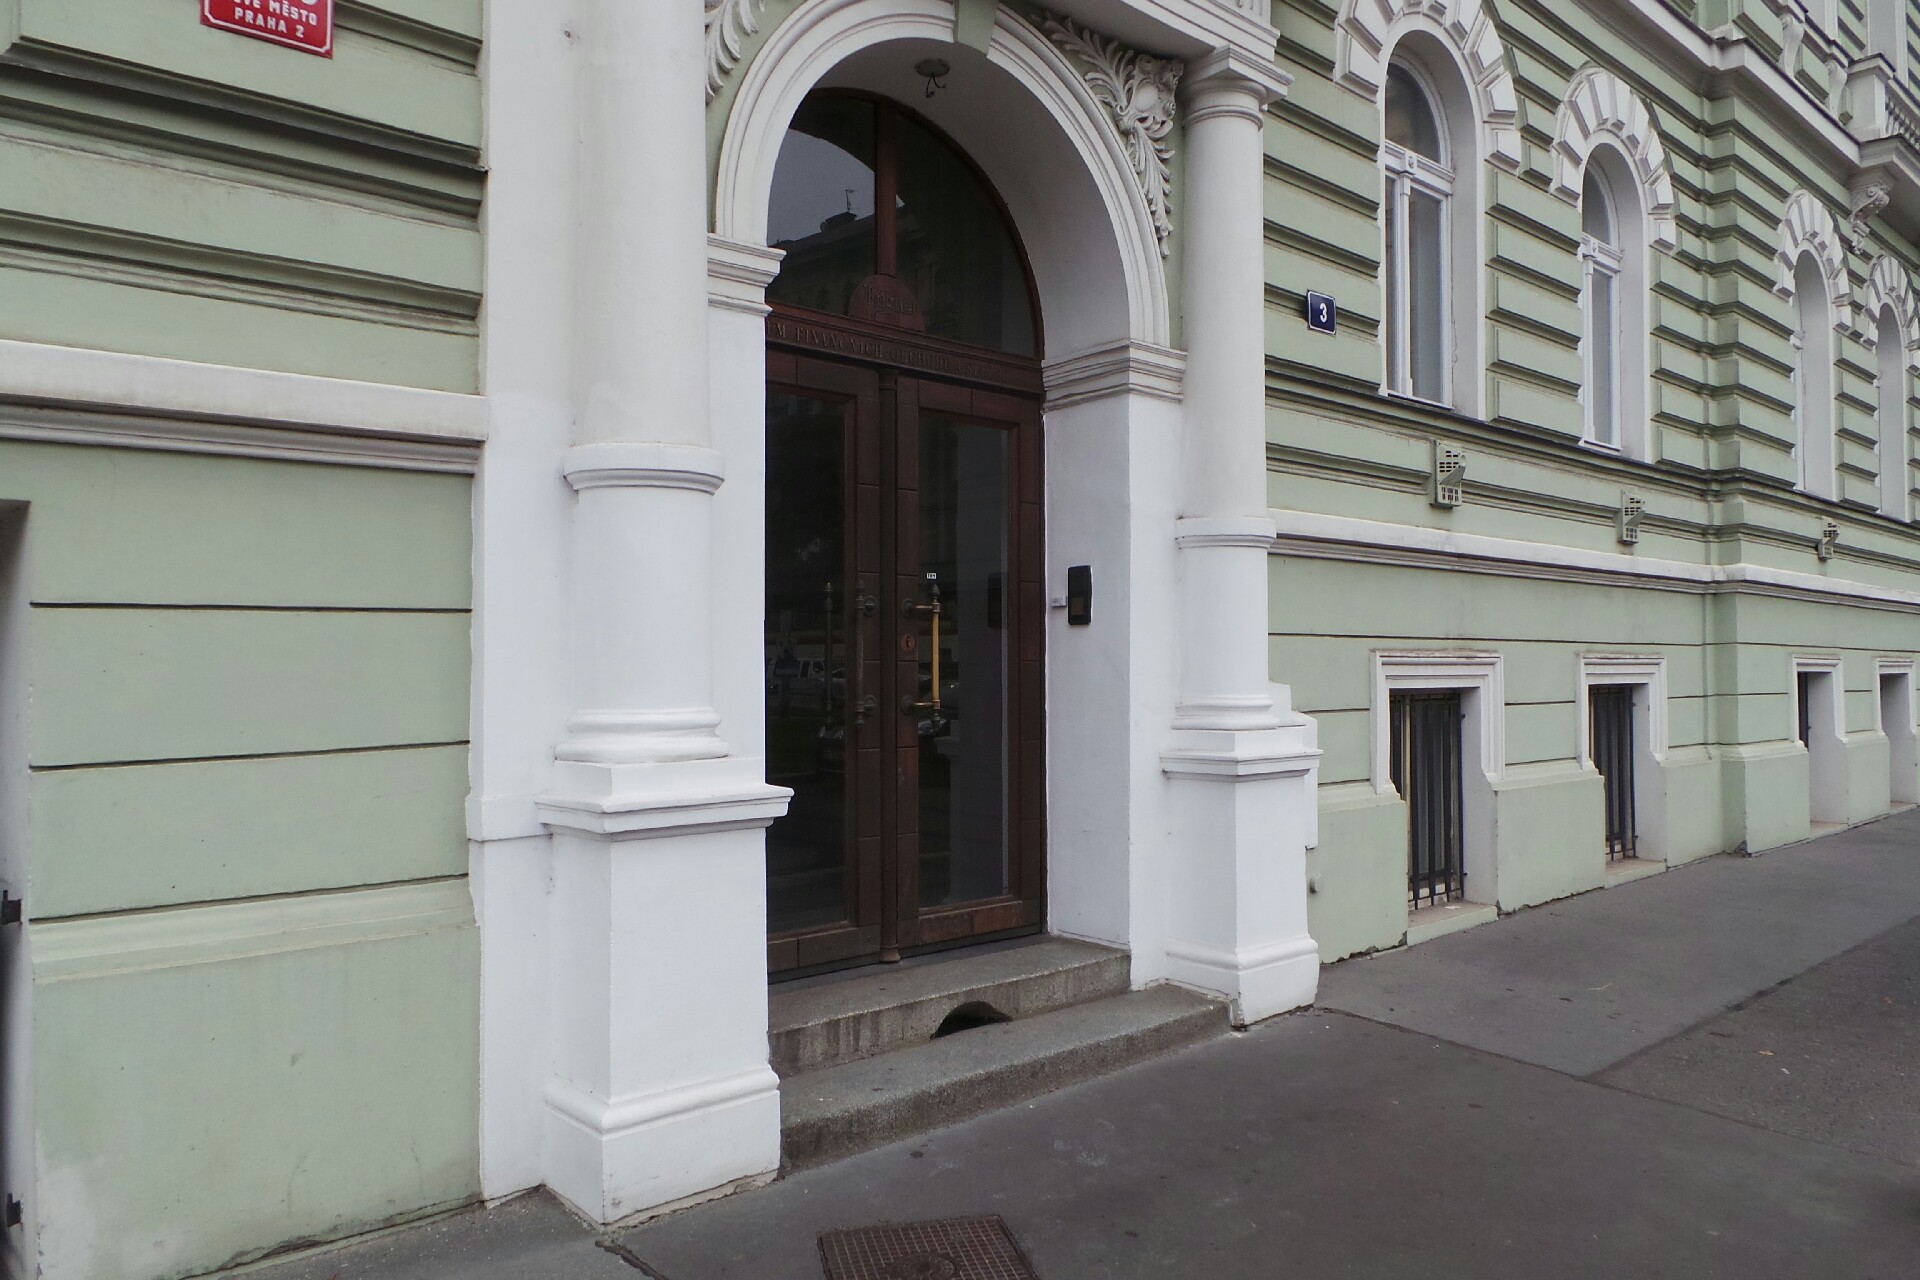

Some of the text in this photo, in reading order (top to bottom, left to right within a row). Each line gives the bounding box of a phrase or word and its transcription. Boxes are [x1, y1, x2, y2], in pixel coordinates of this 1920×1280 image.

[235, 7, 305, 38] PRAHA 2
[269, 0, 317, 26] MĚSTO
[1320, 303, 1328, 323] 3
